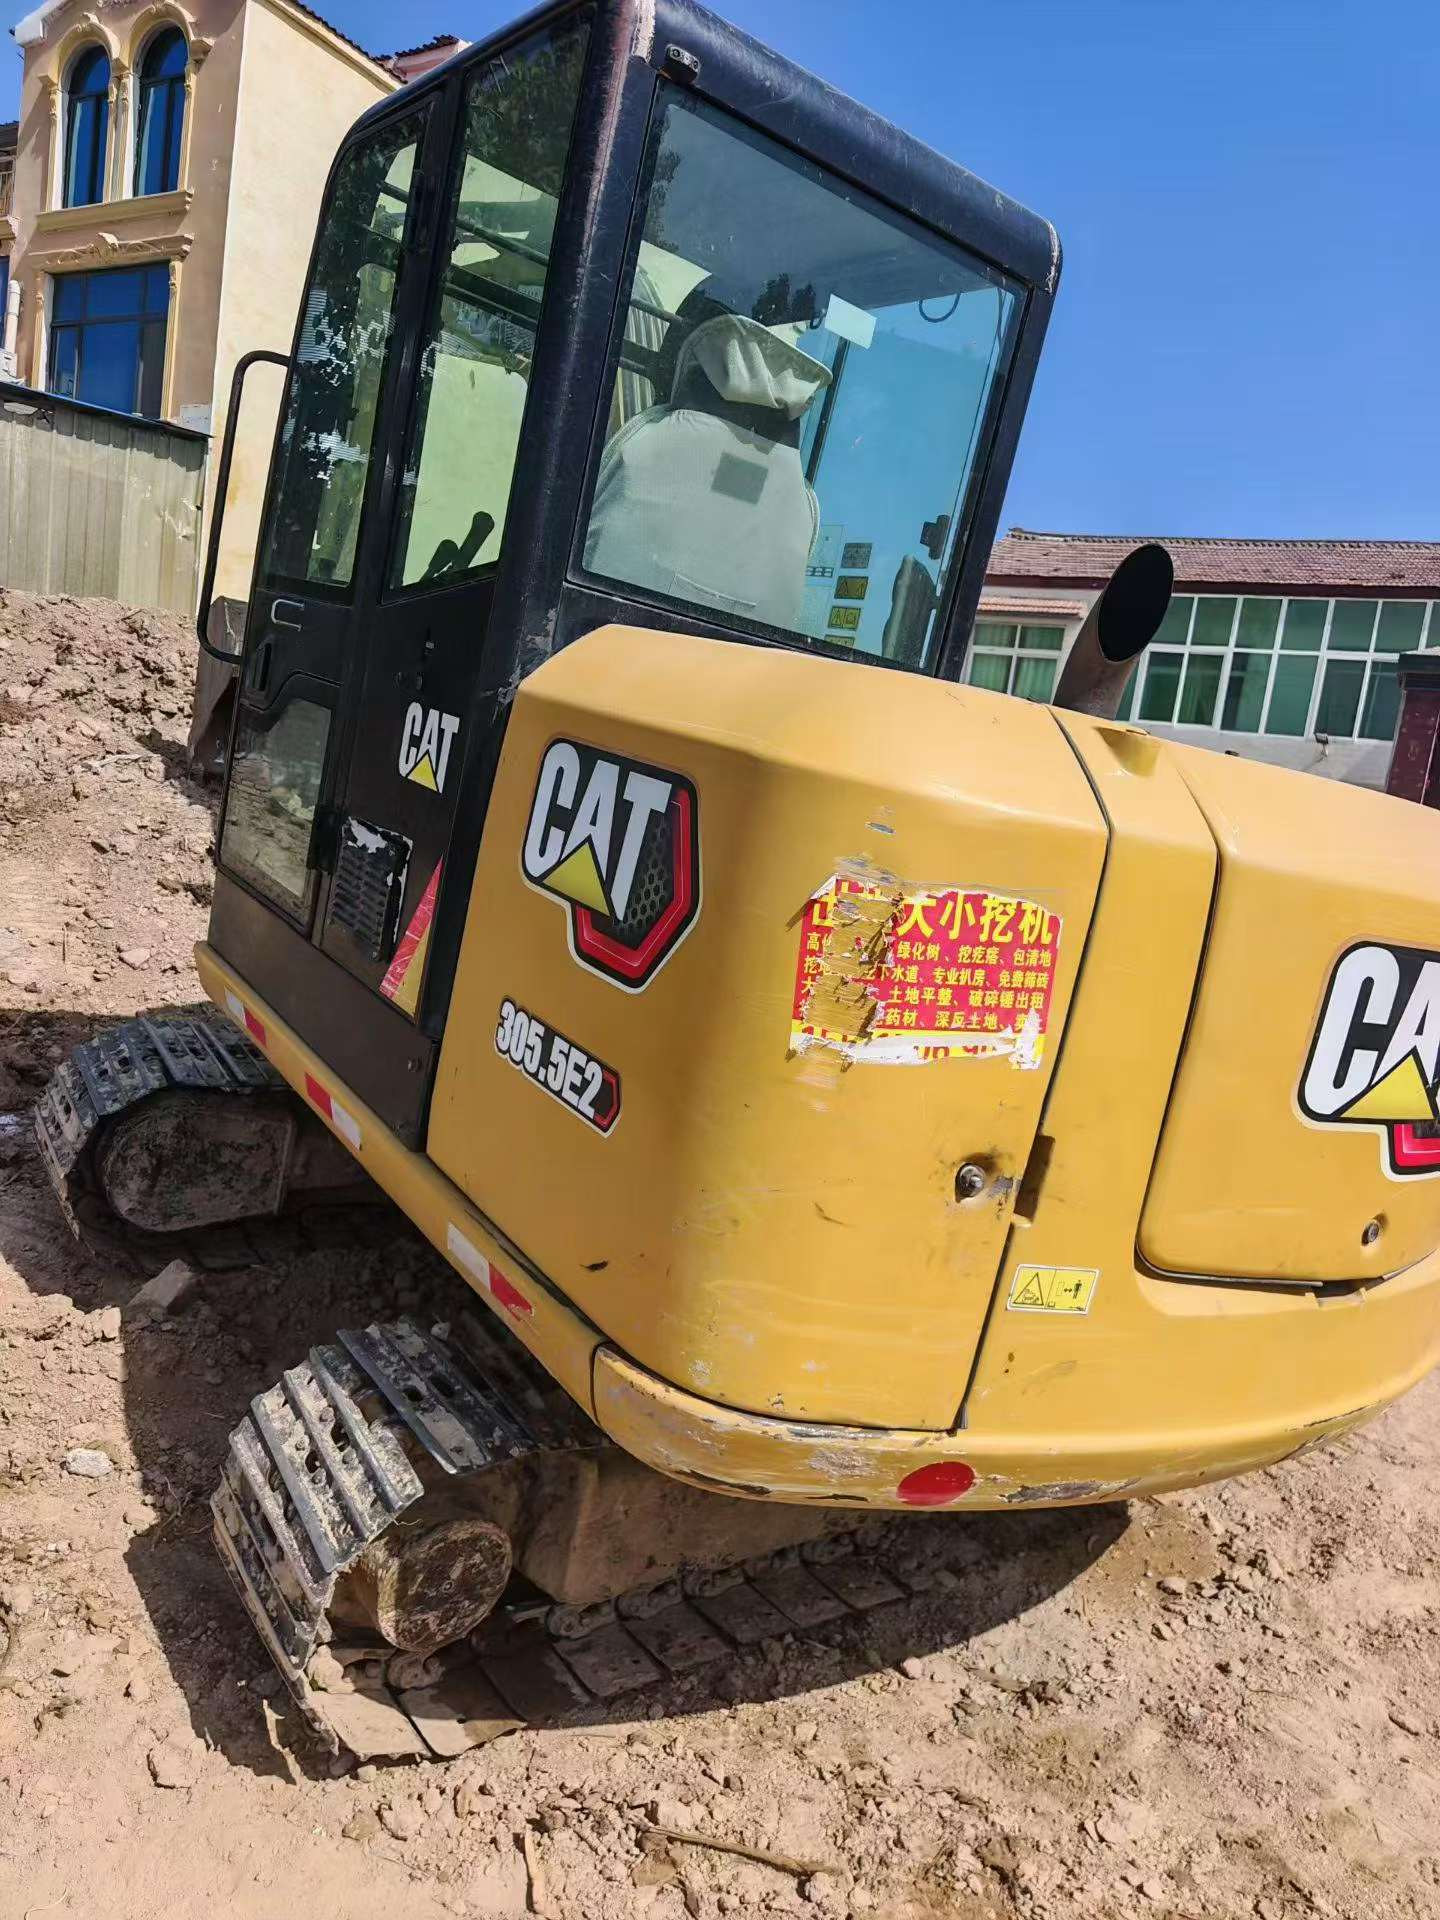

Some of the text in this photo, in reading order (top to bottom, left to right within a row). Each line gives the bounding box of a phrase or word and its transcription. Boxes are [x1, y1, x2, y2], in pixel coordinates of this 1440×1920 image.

[399, 702, 460, 794] CAT
[524, 742, 672, 921] CAT
[496, 999, 604, 1119] 305.5E2
[1304, 946, 1440, 1117] CA
